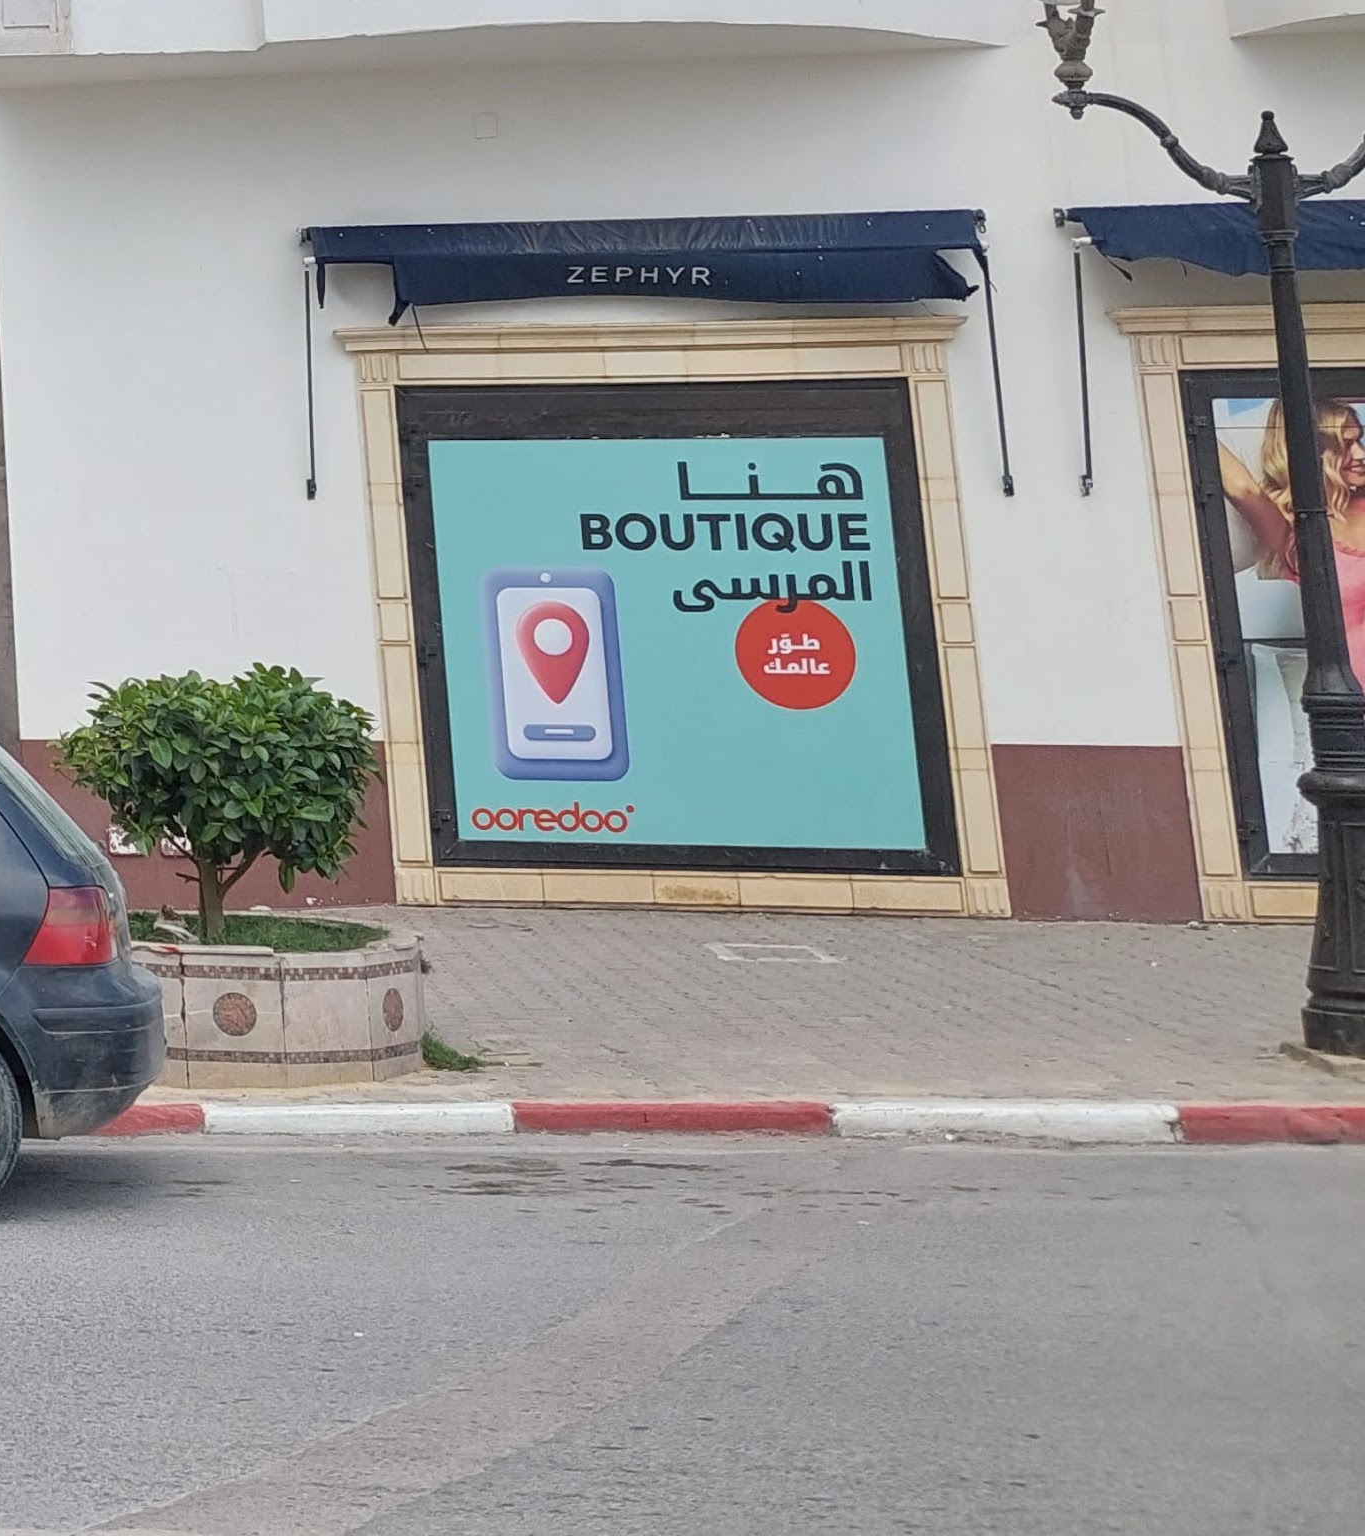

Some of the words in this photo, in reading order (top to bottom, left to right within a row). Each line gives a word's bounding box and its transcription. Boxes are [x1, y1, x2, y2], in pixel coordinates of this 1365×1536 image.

[567, 266, 711, 286] ZEPHYR
[579, 513, 871, 553] BOUTIQUE
[673, 561, 872, 612] المرسى
[763, 658, 831, 675] عالمك
[471, 801, 635, 834] ooredoo
